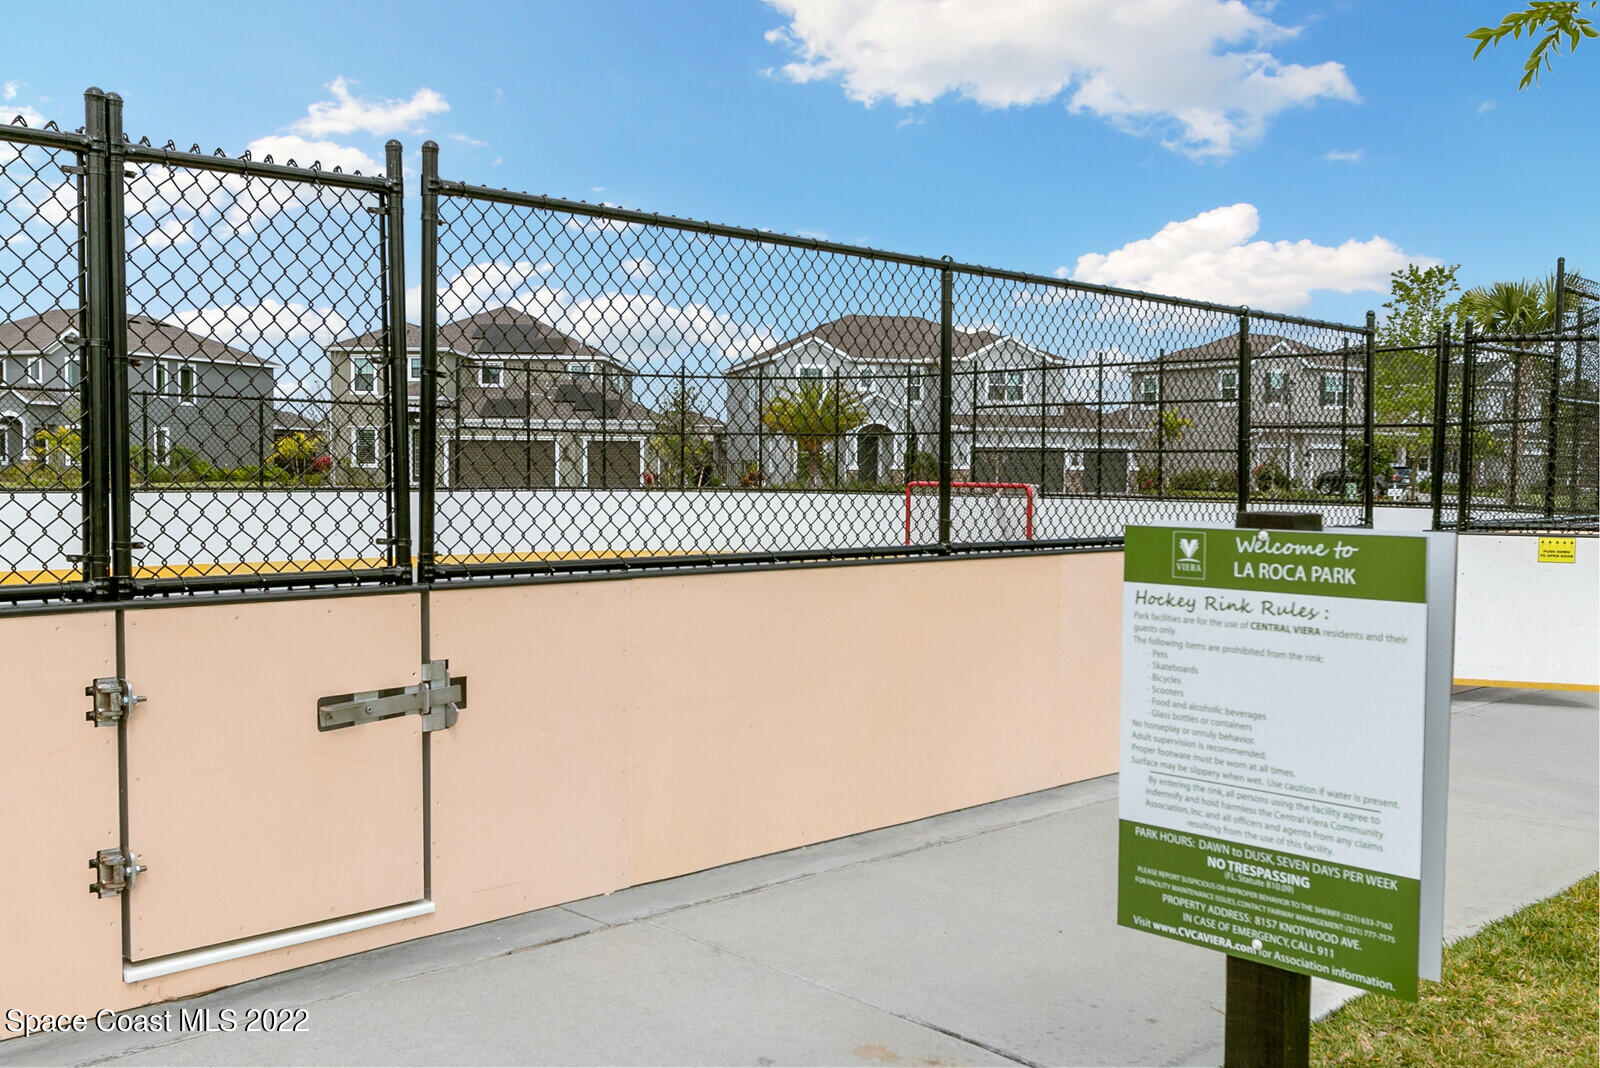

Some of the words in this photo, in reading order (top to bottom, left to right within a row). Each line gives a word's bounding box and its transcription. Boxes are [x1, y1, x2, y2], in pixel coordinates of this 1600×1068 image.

[1235, 535, 1330, 557] Welcome
[1332, 540, 1359, 559] to
[1175, 562, 1202, 573] VIERA
[1233, 561, 1255, 578] LA
[1258, 562, 1307, 582] ROCA
[1310, 565, 1356, 585] PARK
[1135, 589, 1196, 613] Hockey
[1204, 595, 1253, 614] Rink
[1133, 610, 1149, 620] Park
[1150, 612, 1181, 623] facilities
[1196, 616, 1208, 625] for
[1208, 618, 1222, 627] the
[1224, 621, 1238, 629] use
[1239, 621, 1249, 629] of
[1249, 621, 1292, 634] CENTRAL
[1292, 625, 1321, 636] VIERA
[1322, 629, 1364, 640] residents
[1365, 633, 1384, 642] and
[1385, 633, 1408, 644] their
[1133, 624, 1158, 633] guests
[1133, 634, 1147, 645] The
[1147, 636, 1184, 650] following
[1184, 641, 1207, 651] items
[1207, 644, 1221, 653] are
[1221, 645, 1266, 657] prohibited
[1266, 648, 1287, 659] from
[1287, 651, 1304, 662] the
[1152, 648, 1168, 659] Pets
[1151, 660, 1199, 675] Skateboards
[1151, 672, 1182, 685] Bicycles
[1151, 684, 1184, 697] Scooters
[1150, 708, 1171, 720] Glass
[1171, 711, 1199, 724] bottles
[1199, 717, 1210, 725] or
[1209, 719, 1253, 732] containers
[1151, 696, 1171, 708] Food
[1171, 701, 1187, 710] and
[1187, 702, 1223, 715] alcoholic
[1224, 707, 1267, 721] beverages
[1131, 718, 1143, 728] No
[1181, 727, 1191, 735] or
[1131, 730, 1152, 741] Adult
[1152, 735, 1197, 748] supervision
[1198, 741, 1205, 750] is
[1205, 743, 1267, 760] recommended.
[1131, 742, 1156, 755] Proper
[1192, 754, 1213, 764] must
[1213, 756, 1225, 766] be
[1225, 759, 1247, 769] worn
[1248, 763, 1258, 772] at
[1258, 764, 1269, 773] all
[1269, 766, 1296, 778] times.
[1130, 755, 1159, 768] Surface
[1159, 761, 1176, 772] may
[1177, 762, 1188, 773] be
[1189, 765, 1220, 780] slippery
[1221, 771, 1245, 782] when
[1266, 778, 1283, 789] Use
[1283, 782, 1317, 794] caution
[1318, 786, 1325, 796] if
[1326, 790, 1352, 801] water
[1353, 792, 1361, 803] is
[1362, 796, 1400, 809] present.
[1147, 775, 1157, 786] By
[1158, 778, 1191, 792] entering
[1191, 783, 1206, 793] the
[1224, 789, 1235, 799] all
[1236, 792, 1269, 805] persons
[1270, 798, 1294, 811] using
[1295, 801, 1310, 812] the
[1311, 803, 1341, 819] facility
[1342, 811, 1369, 823] agree
[1370, 815, 1381, 825] to
[1183, 795, 1200, 804] and
[1200, 796, 1220, 808] hold
[1220, 800, 1257, 815] harmless
[1257, 807, 1273, 818] the
[1273, 810, 1305, 824] Central
[1305, 816, 1329, 829] Viera
[1329, 820, 1384, 840] Community
[1203, 811, 1221, 821] and
[1221, 813, 1232, 822] all
[1232, 815, 1263, 829] officers
[1263, 822, 1281, 832] and
[1281, 825, 1312, 838] agents
[1312, 829, 1334, 842] from
[1335, 836, 1353, 848] any
[1353, 839, 1384, 853] claims
[1186, 819, 1222, 835] resulting
[1222, 824, 1243, 837] from
[1243, 830, 1258, 840] the
[1258, 835, 1274, 844] use
[1275, 836, 1285, 845] of
[1285, 838, 1302, 849] this
[1134, 825, 1158, 840] PARK
[1159, 830, 1196, 848] HOURS:
[1198, 838, 1230, 855] DAWN
[1231, 847, 1243, 858] to
[1276, 855, 1310, 872] SEVEN
[1311, 862, 1341, 879] DAYS
[1342, 868, 1364, 884] PER
[1364, 873, 1398, 891] WEEK
[1207, 855, 1226, 870] NO
[1226, 859, 1310, 889] TRESPASSING
[1161, 892, 1206, 912] PROPERTY
[1207, 904, 1252, 924] ADDRESS:
[1254, 915, 1278, 929] 8157
[1278, 920, 1339, 945] KNOTWOOD
[1339, 936, 1362, 951] AVE.
[1182, 911, 1192, 923] IN
[1193, 914, 1216, 929] CASE
[1217, 920, 1231, 932] OF
[1290, 938, 1316, 954] CALL
[1316, 945, 1334, 959] 911
[1132, 914, 1151, 928] Visit
[1152, 921, 1258, 955] www.CVCAVIERA.com
[1256, 944, 1272, 959] for
[1273, 950, 1330, 974] Association
[1331, 965, 1396, 992] information.
